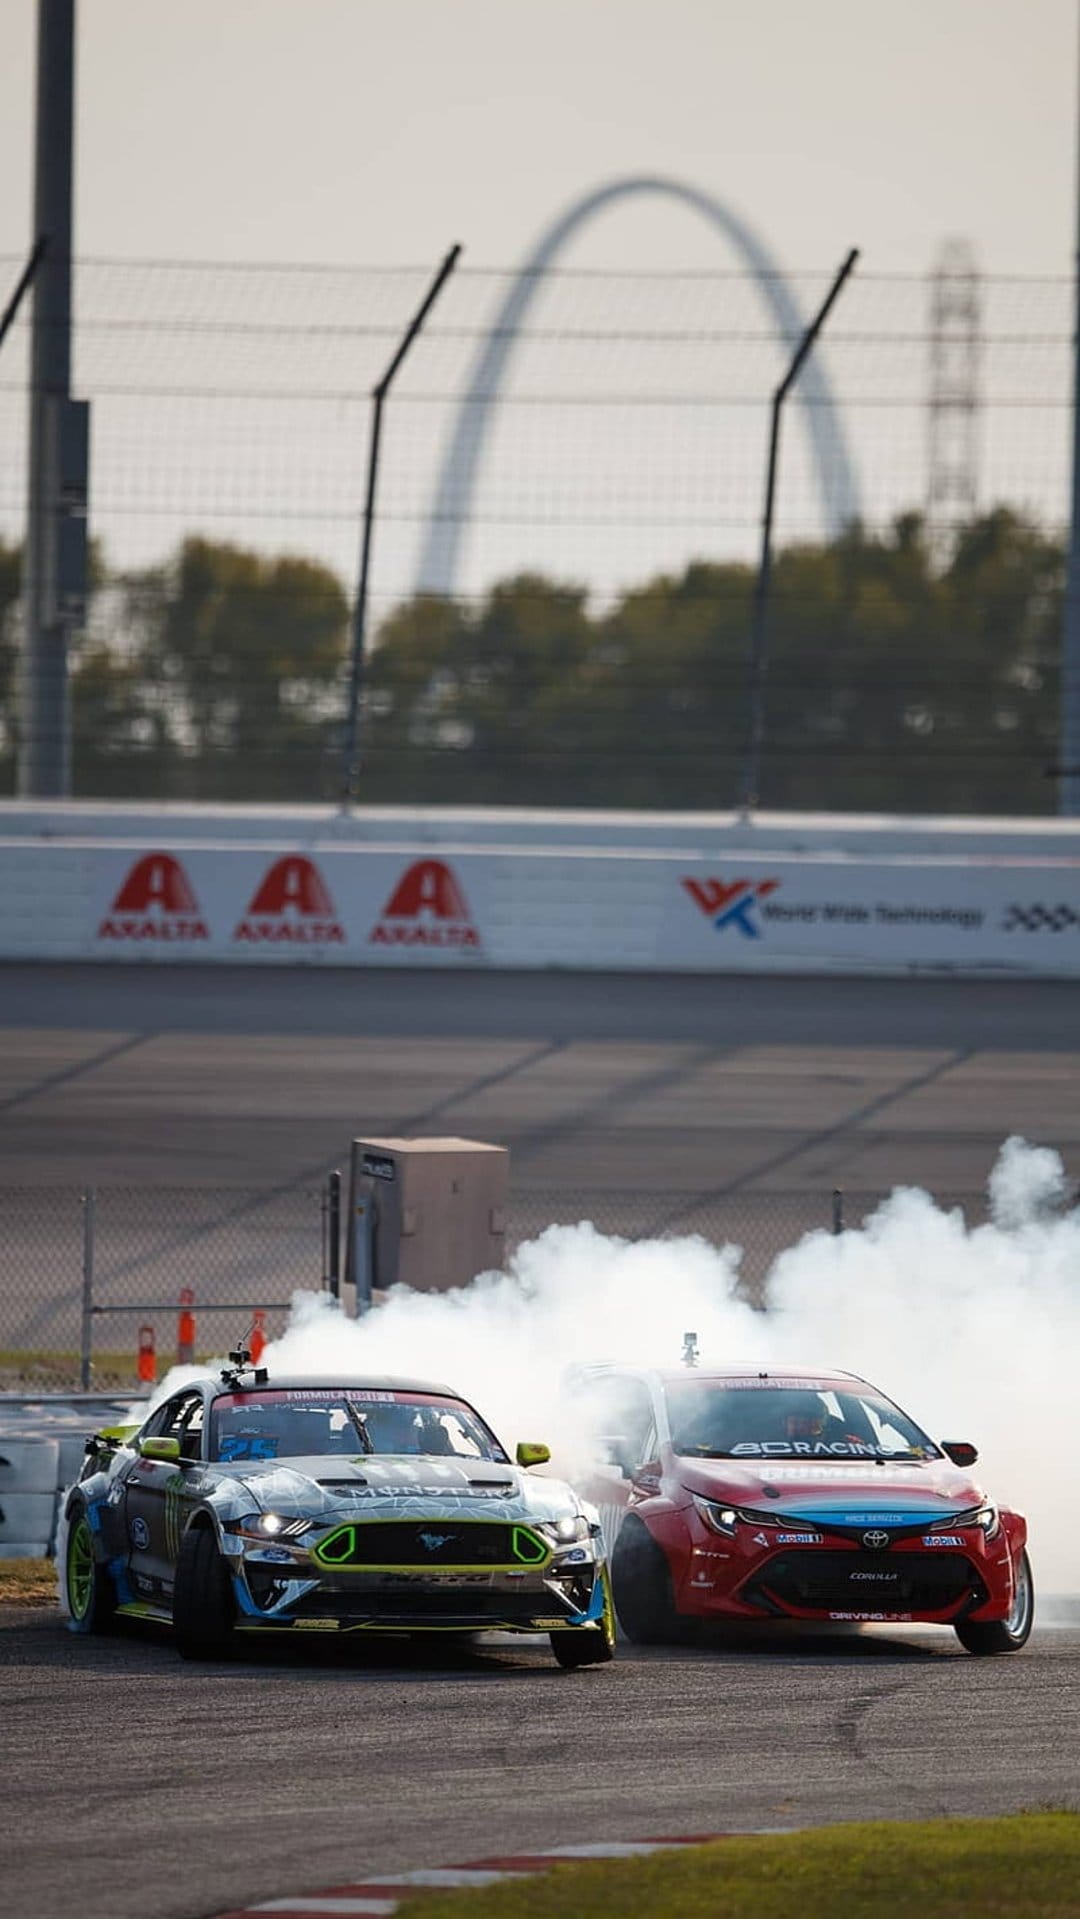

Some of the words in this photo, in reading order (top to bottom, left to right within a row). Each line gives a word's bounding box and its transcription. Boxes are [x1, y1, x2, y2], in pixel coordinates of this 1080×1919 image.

[876, 905, 984, 930] Technology
[97, 919, 210, 941] AXALTA
[233, 922, 347, 944] AXALTA
[369, 924, 483, 948] AXALTA
[286, 1390, 346, 1402] FORMULA
[777, 1534, 810, 1544] Mobil
[922, 1536, 954, 1546] Mobil
